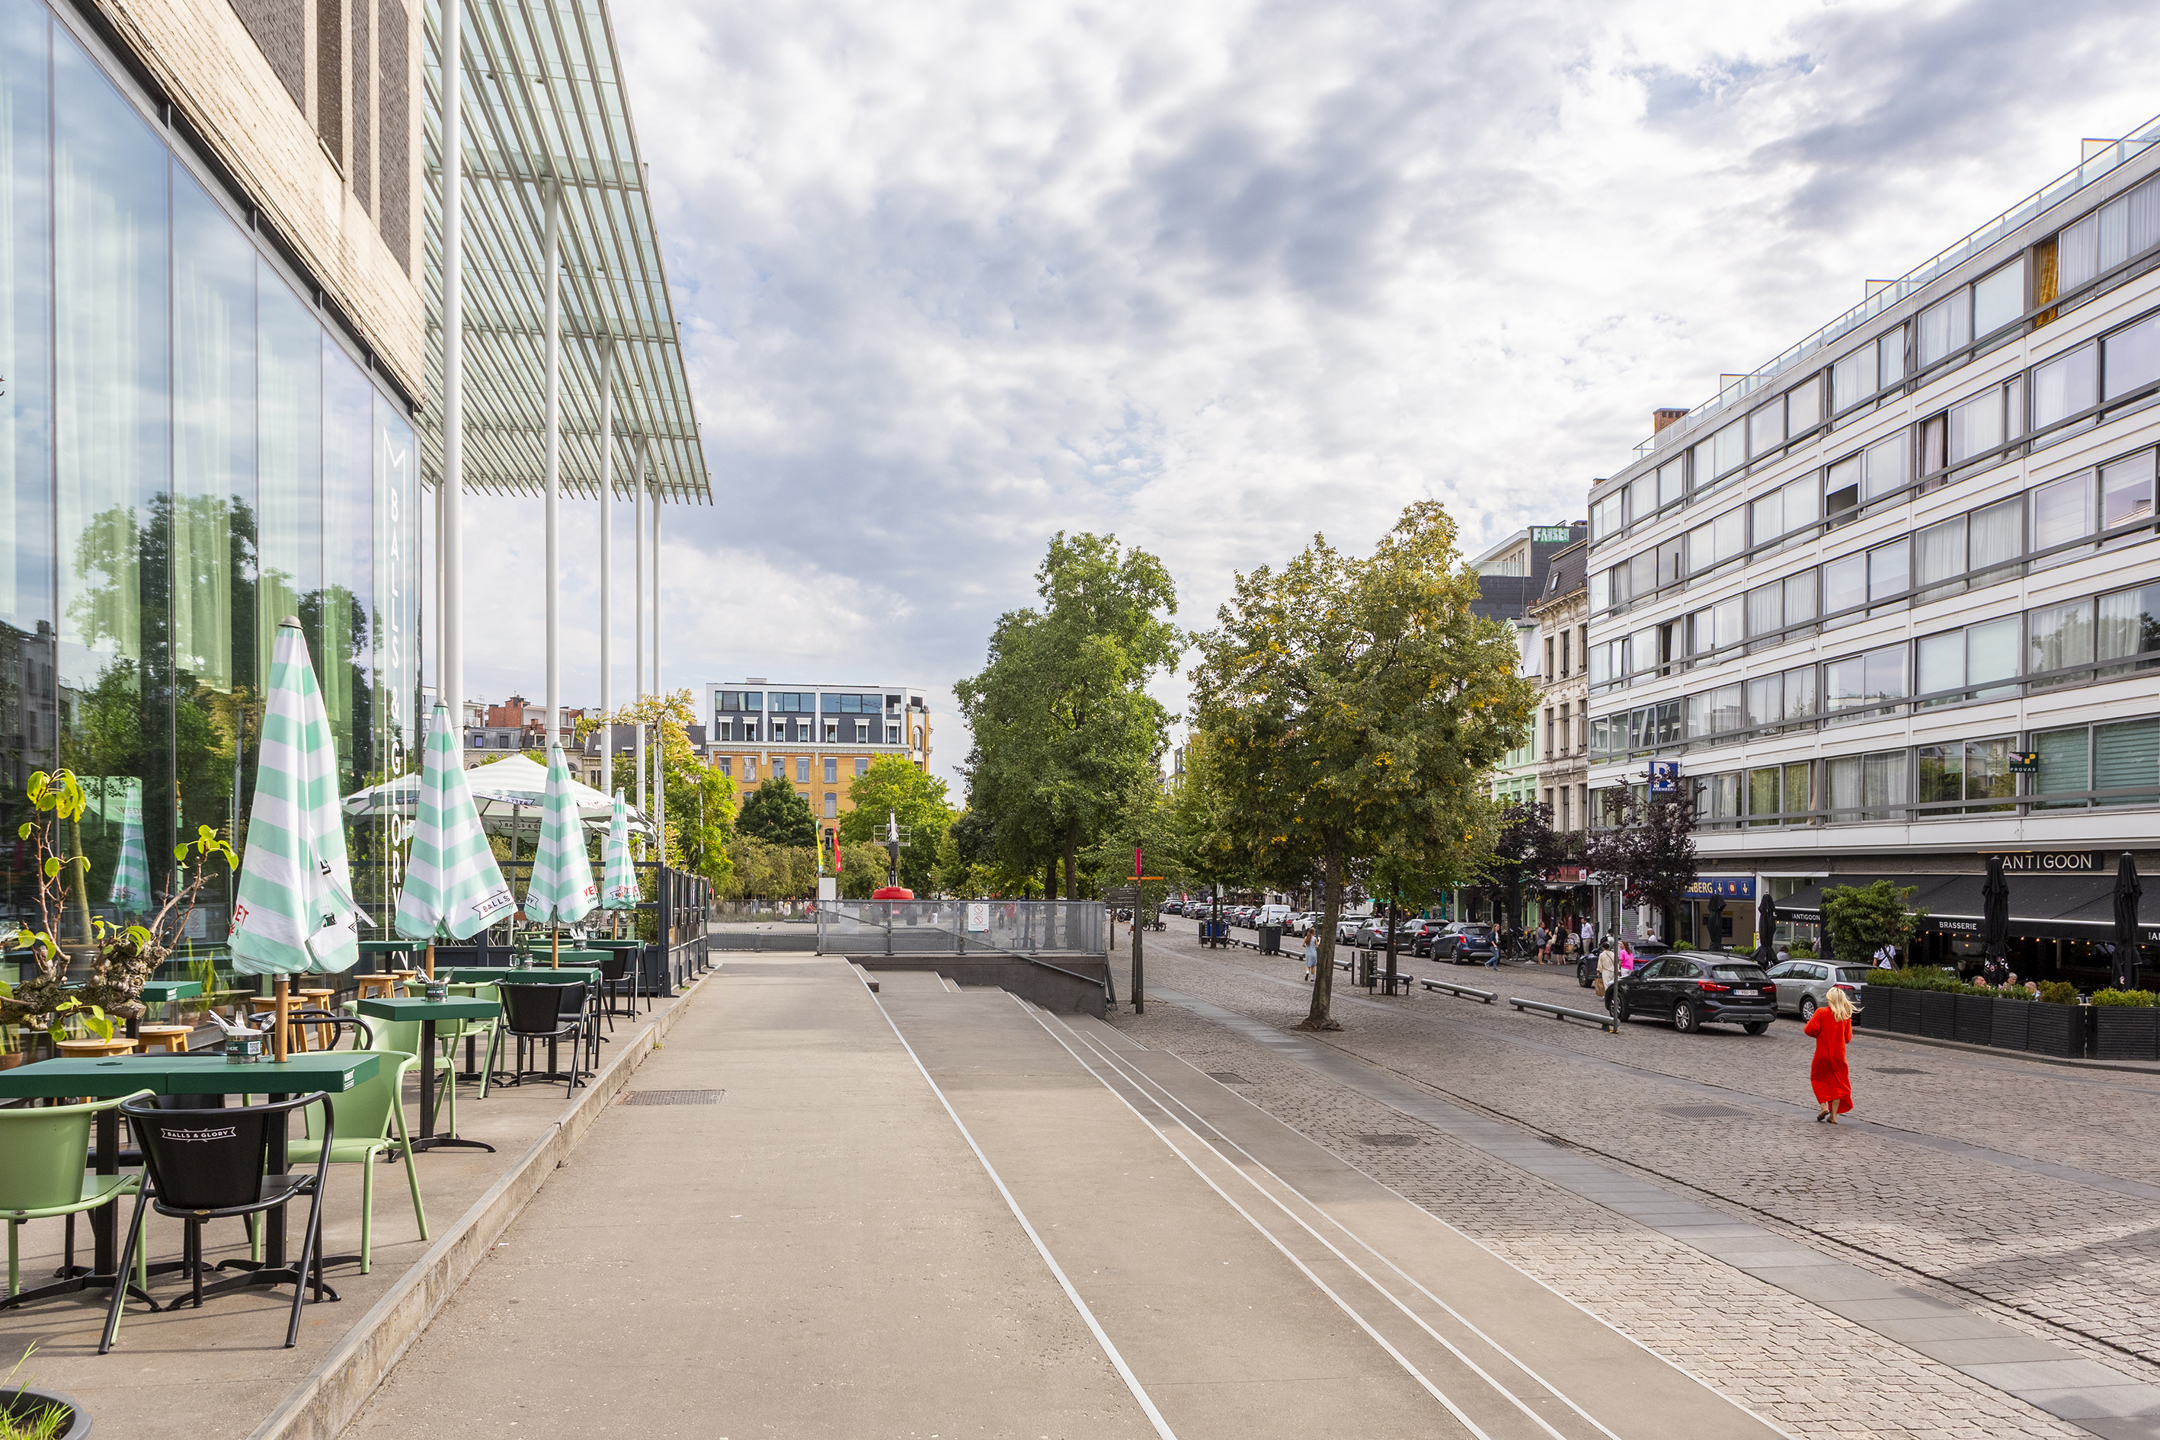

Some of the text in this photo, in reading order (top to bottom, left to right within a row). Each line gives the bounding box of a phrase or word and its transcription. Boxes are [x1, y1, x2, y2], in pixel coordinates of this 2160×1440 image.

[390, 486, 402, 917] BALLS & GLORY
[2001, 853, 2093, 869] ANTIGOON
[482, 895, 511, 913] BALLS
[1939, 921, 1978, 930] BRASSERIE
[200, 1130, 228, 1138] GLORY
